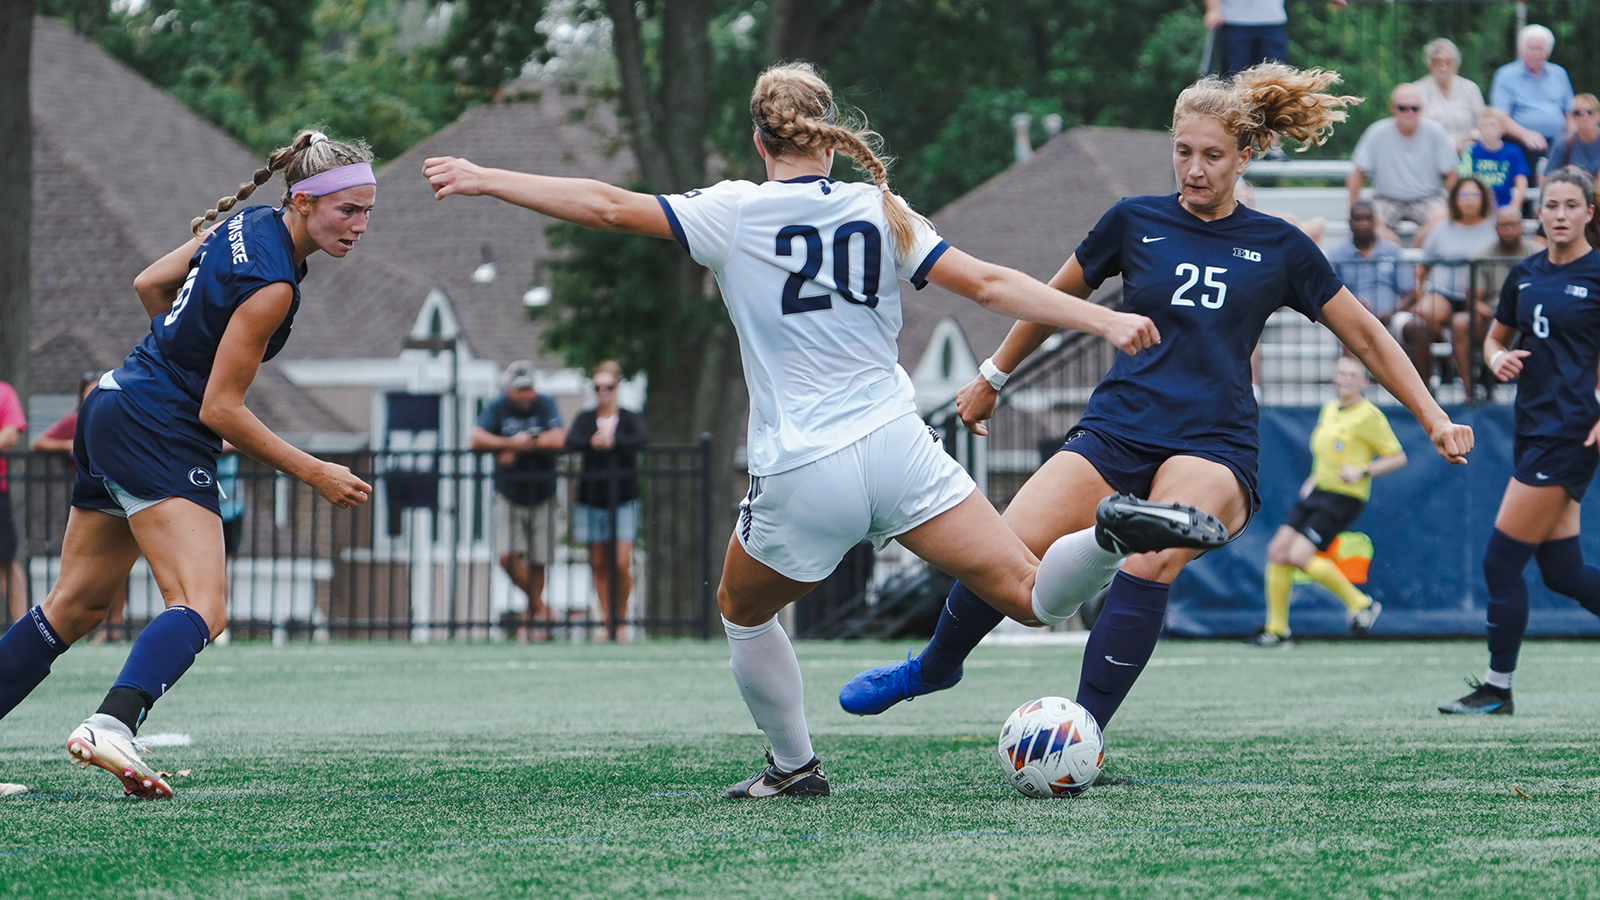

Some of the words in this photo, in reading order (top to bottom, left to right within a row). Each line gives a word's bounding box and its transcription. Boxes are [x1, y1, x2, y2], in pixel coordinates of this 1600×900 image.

[228, 230, 249, 265] STATE
[775, 220, 881, 315] 20
[1171, 263, 1228, 309] 25
[1533, 303, 1549, 339] 6
[39, 622, 56, 644] GRIP
